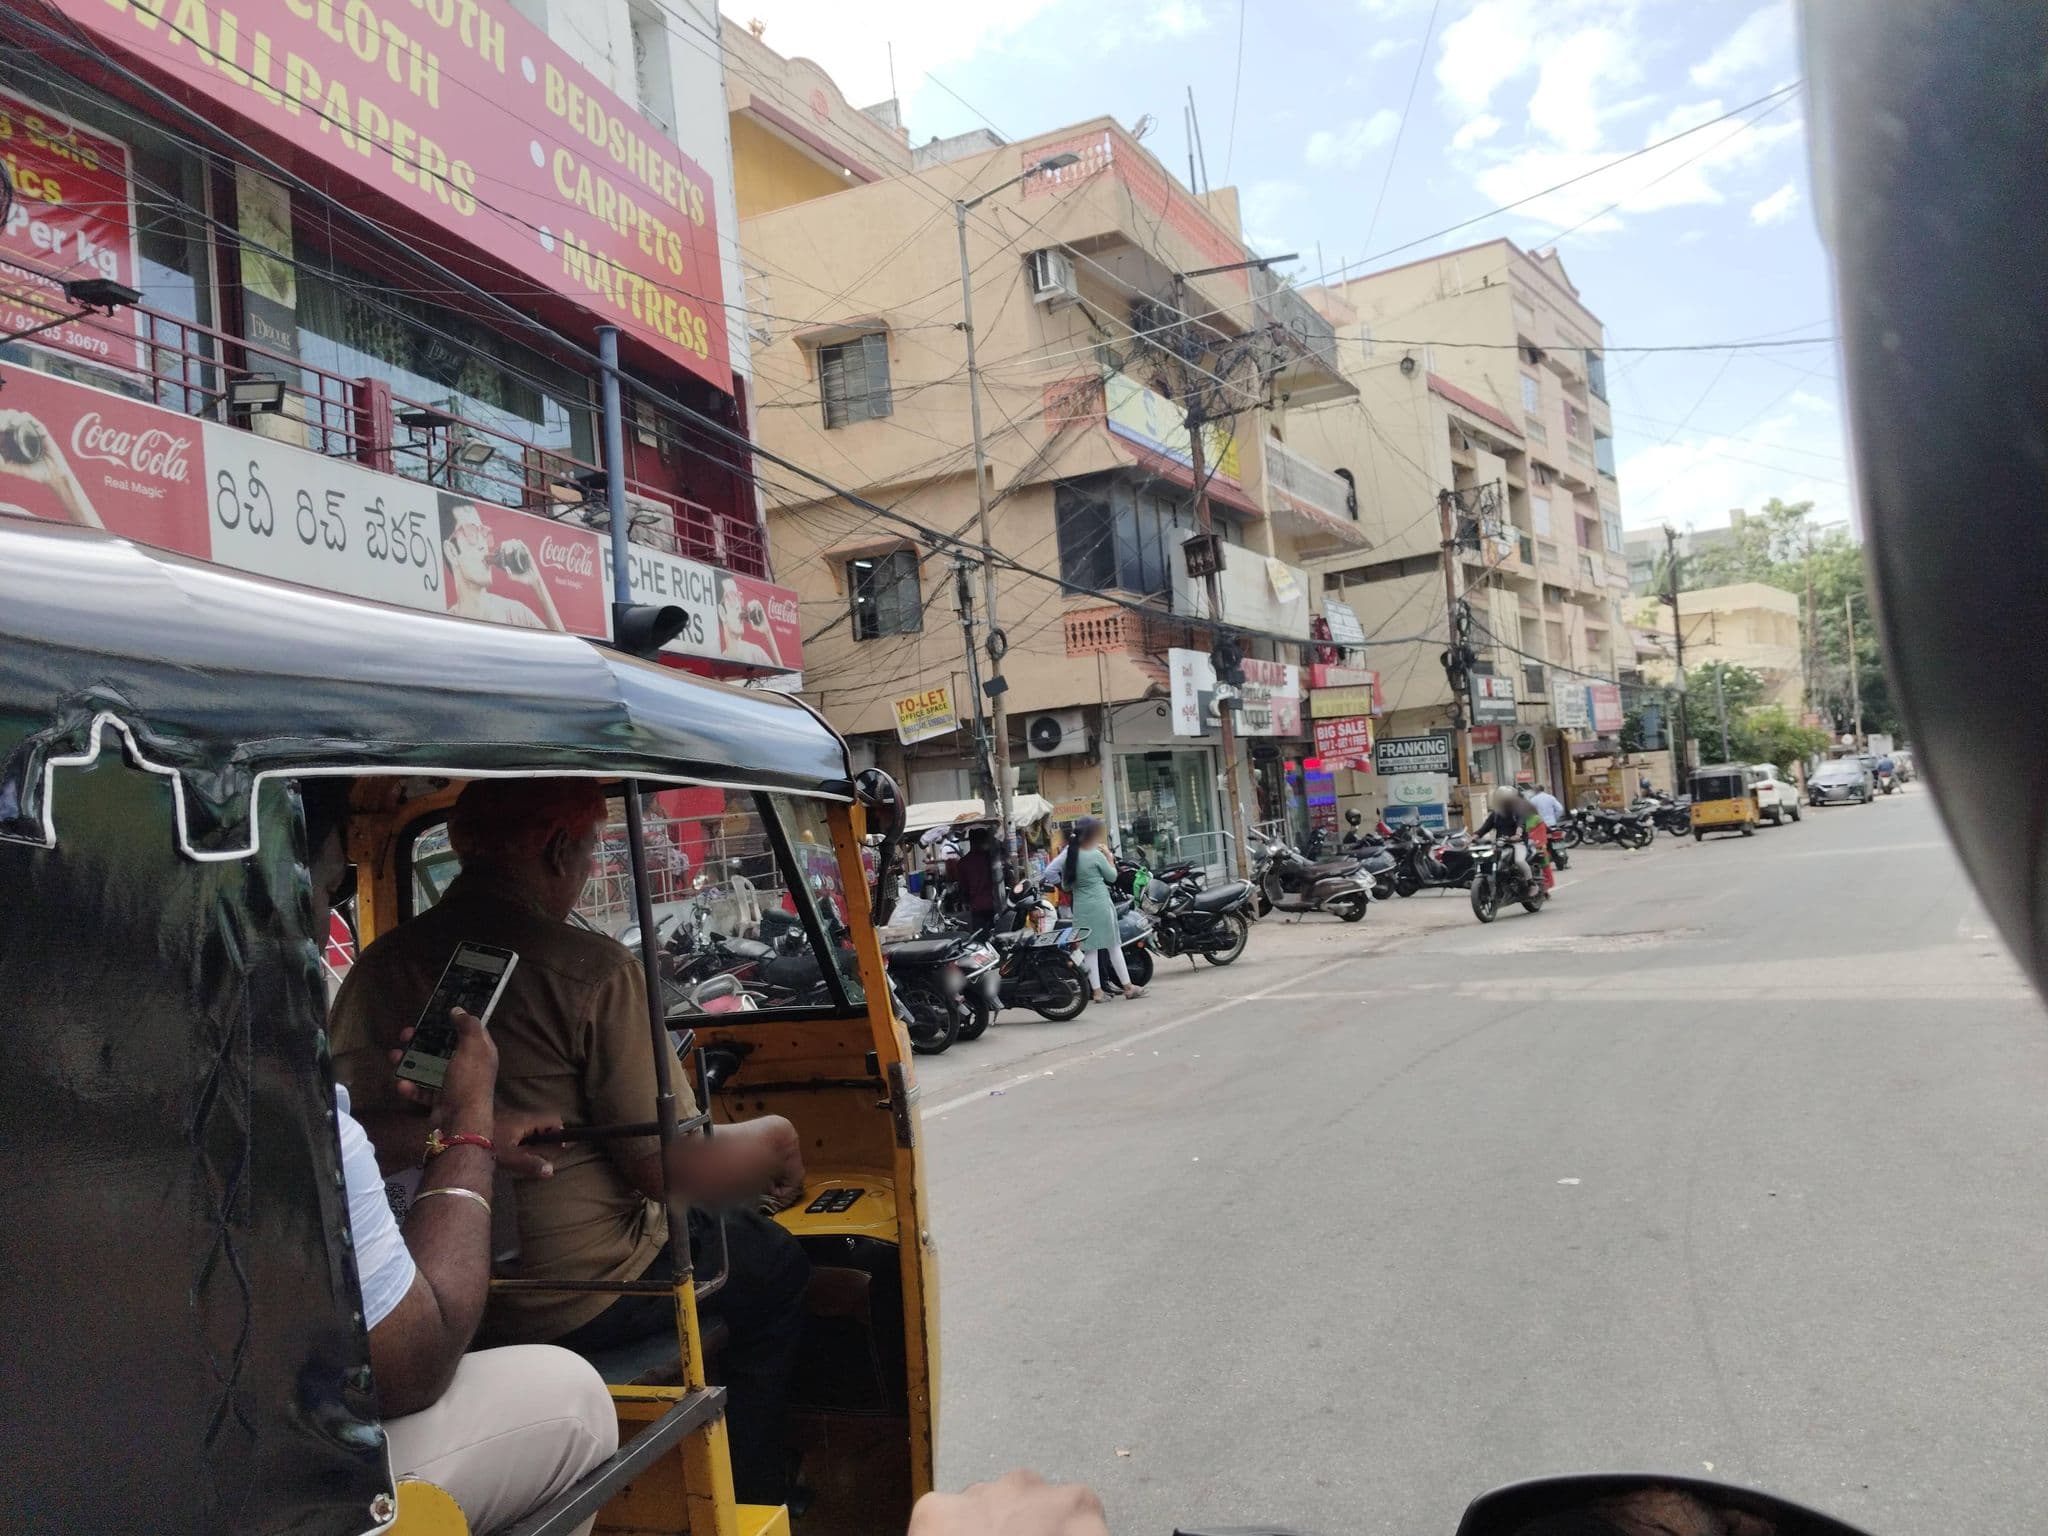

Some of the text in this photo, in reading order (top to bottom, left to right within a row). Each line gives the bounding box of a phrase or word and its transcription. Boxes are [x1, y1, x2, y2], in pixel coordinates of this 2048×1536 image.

[284, 0, 439, 109] LOTH
[409, 0, 505, 74] OTH
[25, 115, 99, 171] Sale
[545, 62, 705, 226] BEDSHEETS
[553, 148, 684, 276] CARPETS
[7, 202, 66, 254] Per
[77, 230, 118, 281] kg
[563, 228, 708, 360] MATTRESS
[66, 330, 109, 355] 30679
[104, 475, 129, 491] Real
[603, 547, 715, 607] RCHE RICH
[896, 688, 945, 714] TO-LET
[900, 702, 948, 722] OFFICE SPACE
[1316, 720, 1366, 740] BIG SALE
[1380, 740, 1446, 757] FRANKING
